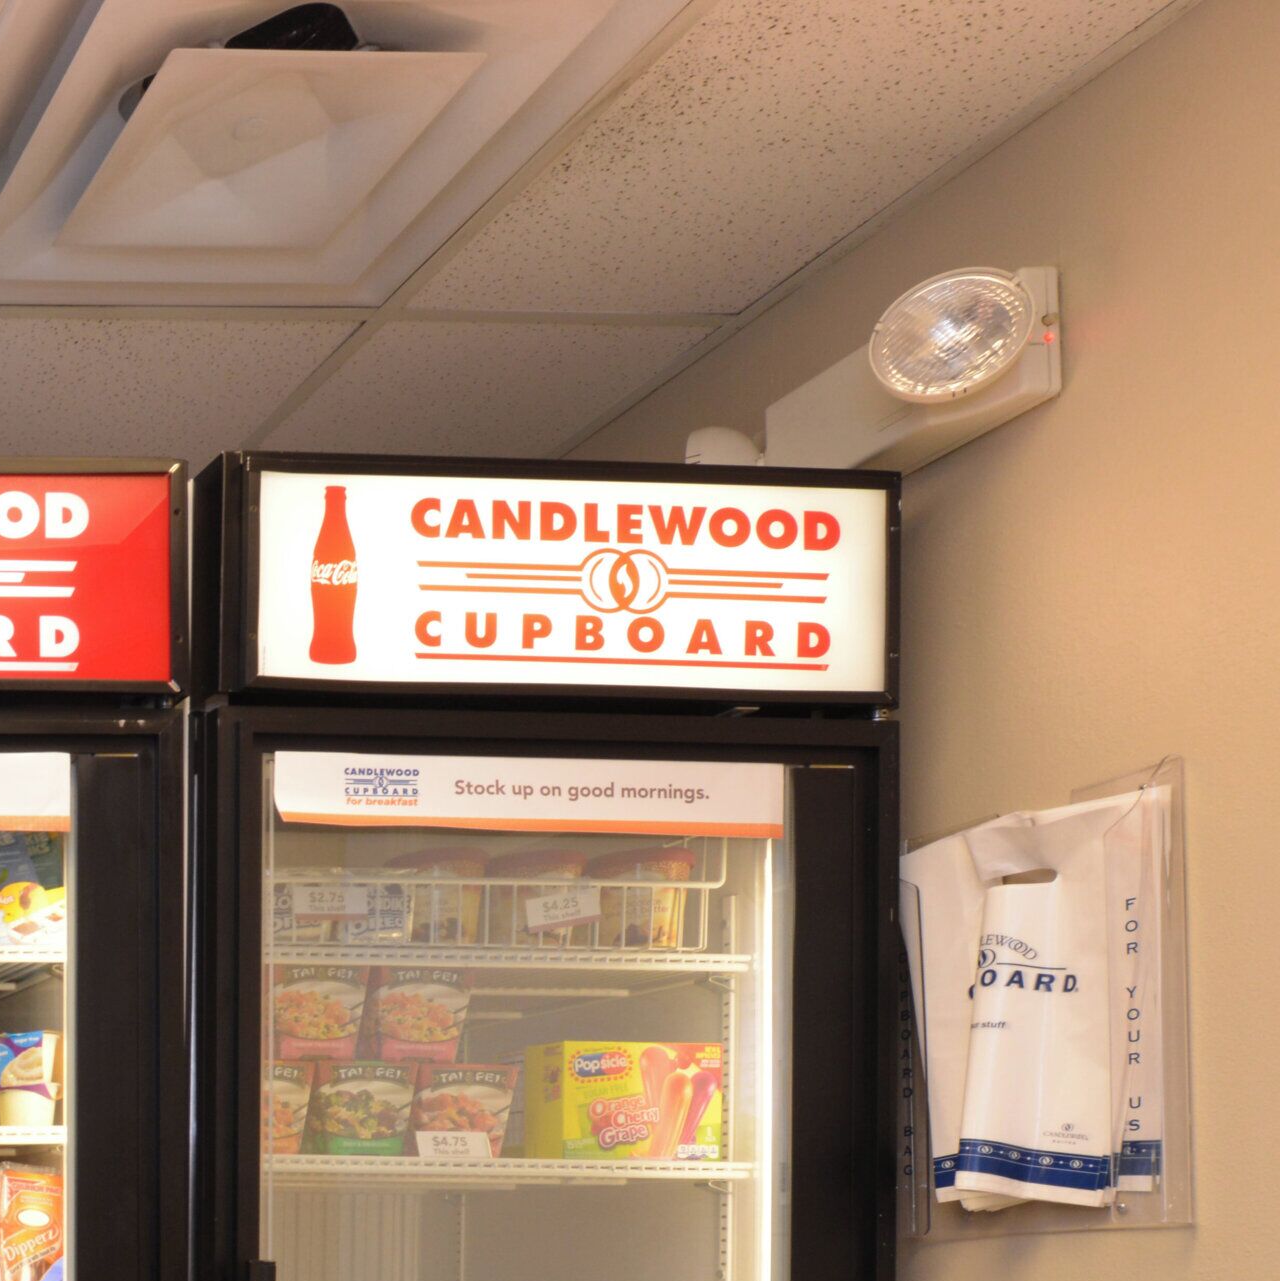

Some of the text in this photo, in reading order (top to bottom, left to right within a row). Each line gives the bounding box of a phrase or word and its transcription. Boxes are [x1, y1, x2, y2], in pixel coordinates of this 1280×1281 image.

[410, 497, 841, 551] CANDLEWOOD
[415, 611, 830, 658] CUPBOARD
[344, 767, 420, 777] CANDLEWOOD
[345, 787, 418, 796] CUPBOARD
[455, 779, 709, 804] Stock up on good mornings.
[366, 797, 418, 807] breakfast
[542, 897, 578, 911] $4.25
[293, 969, 314, 979] TAI
[398, 971, 419, 981] TAI
[1125, 898, 1140, 1065] FOR YOUR
[574, 1053, 627, 1072] Popsicle
[339, 1068, 362, 1079] TAI
[440, 1072, 462, 1083] TAI
[611, 1108, 659, 1128] Cherry
[432, 1136, 468, 1147] $4.75
[600, 1125, 648, 1148] Grape
[3, 1229, 59, 1261] Dipperz
